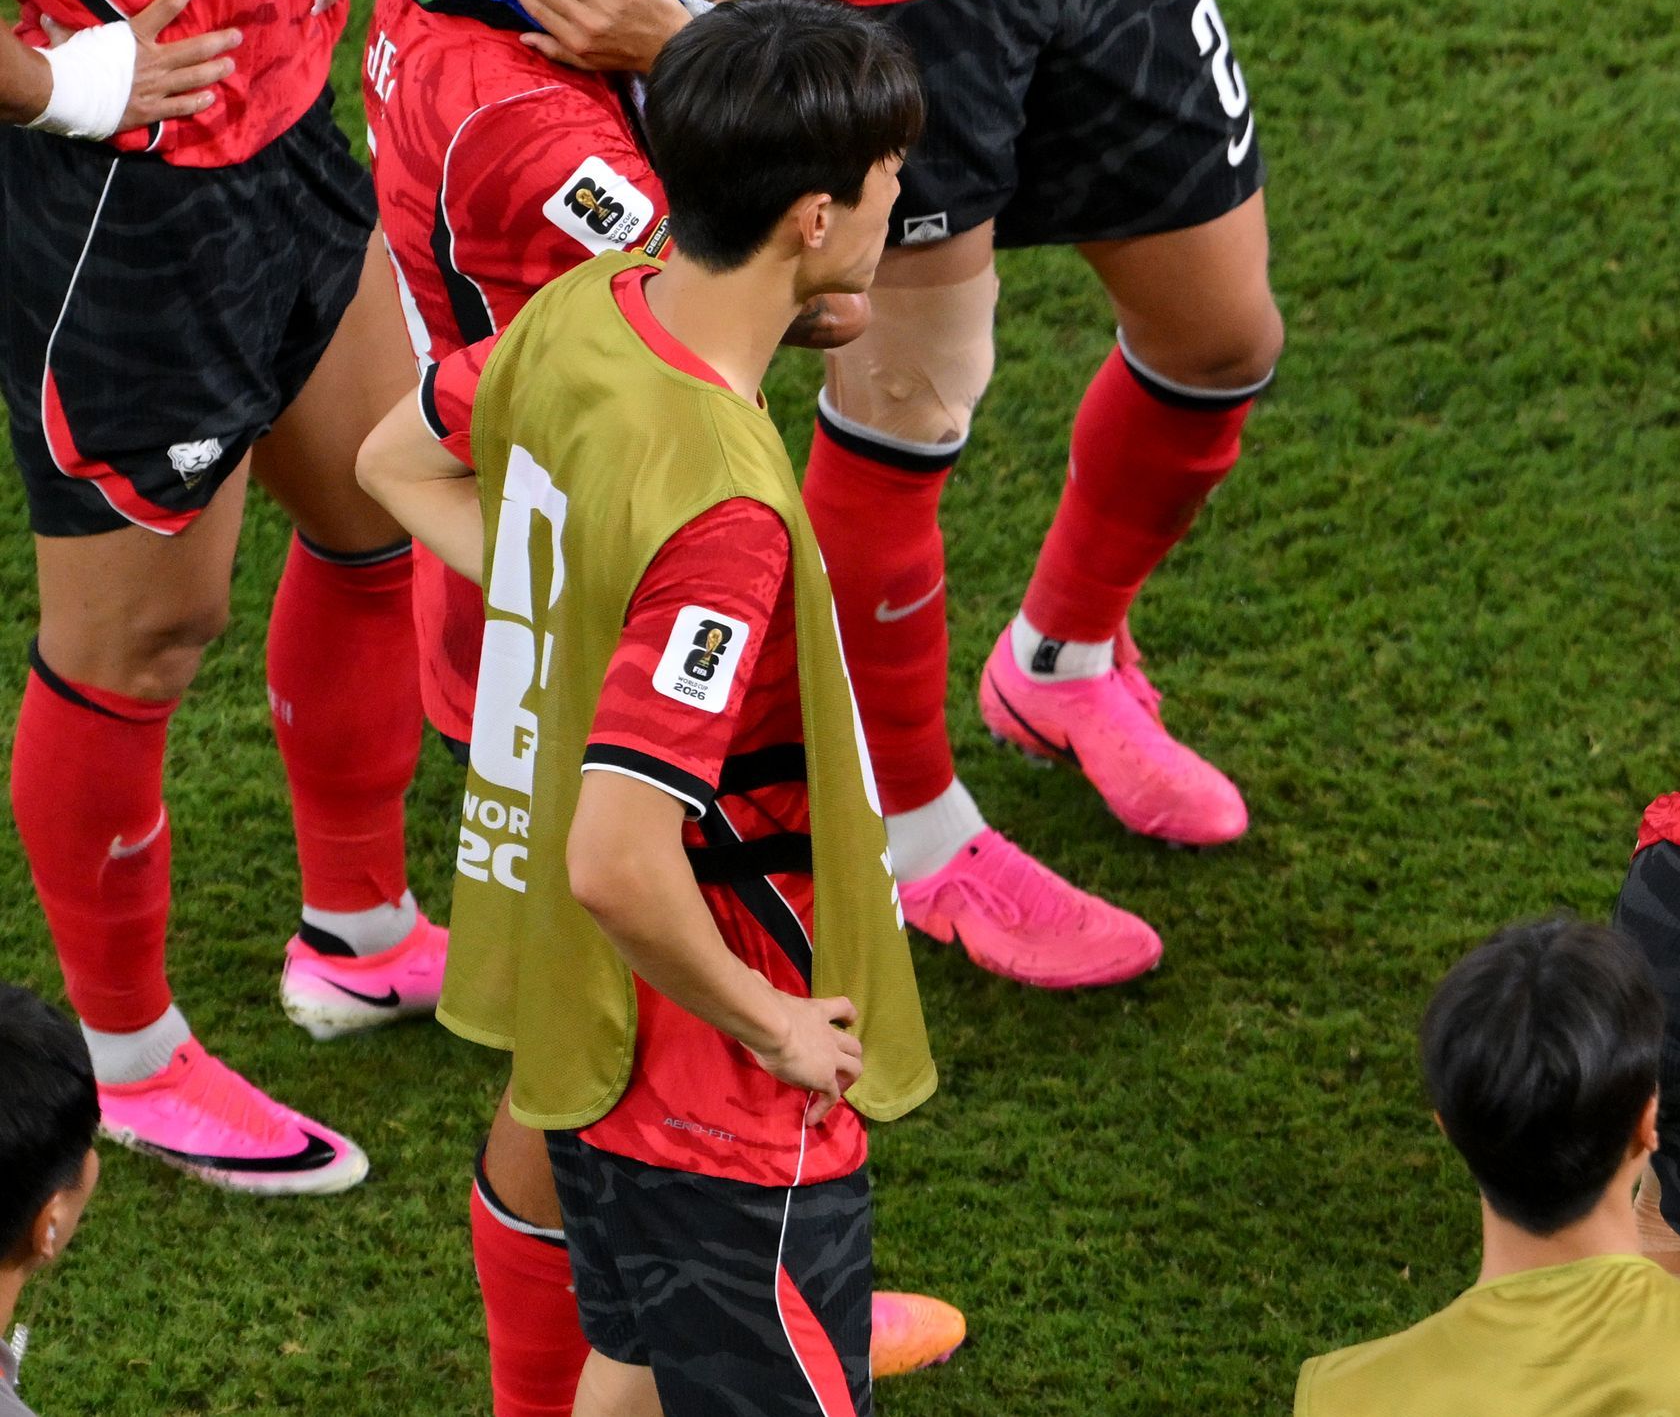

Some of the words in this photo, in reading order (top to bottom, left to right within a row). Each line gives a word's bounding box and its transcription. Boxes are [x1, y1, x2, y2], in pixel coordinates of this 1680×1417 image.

[646, 219, 669, 254] DEBUT
[692, 665, 708, 677] FIFA
[673, 682, 706, 701] 2026
[678, 676, 698, 688] WORLD
[697, 682, 709, 692] CUP
